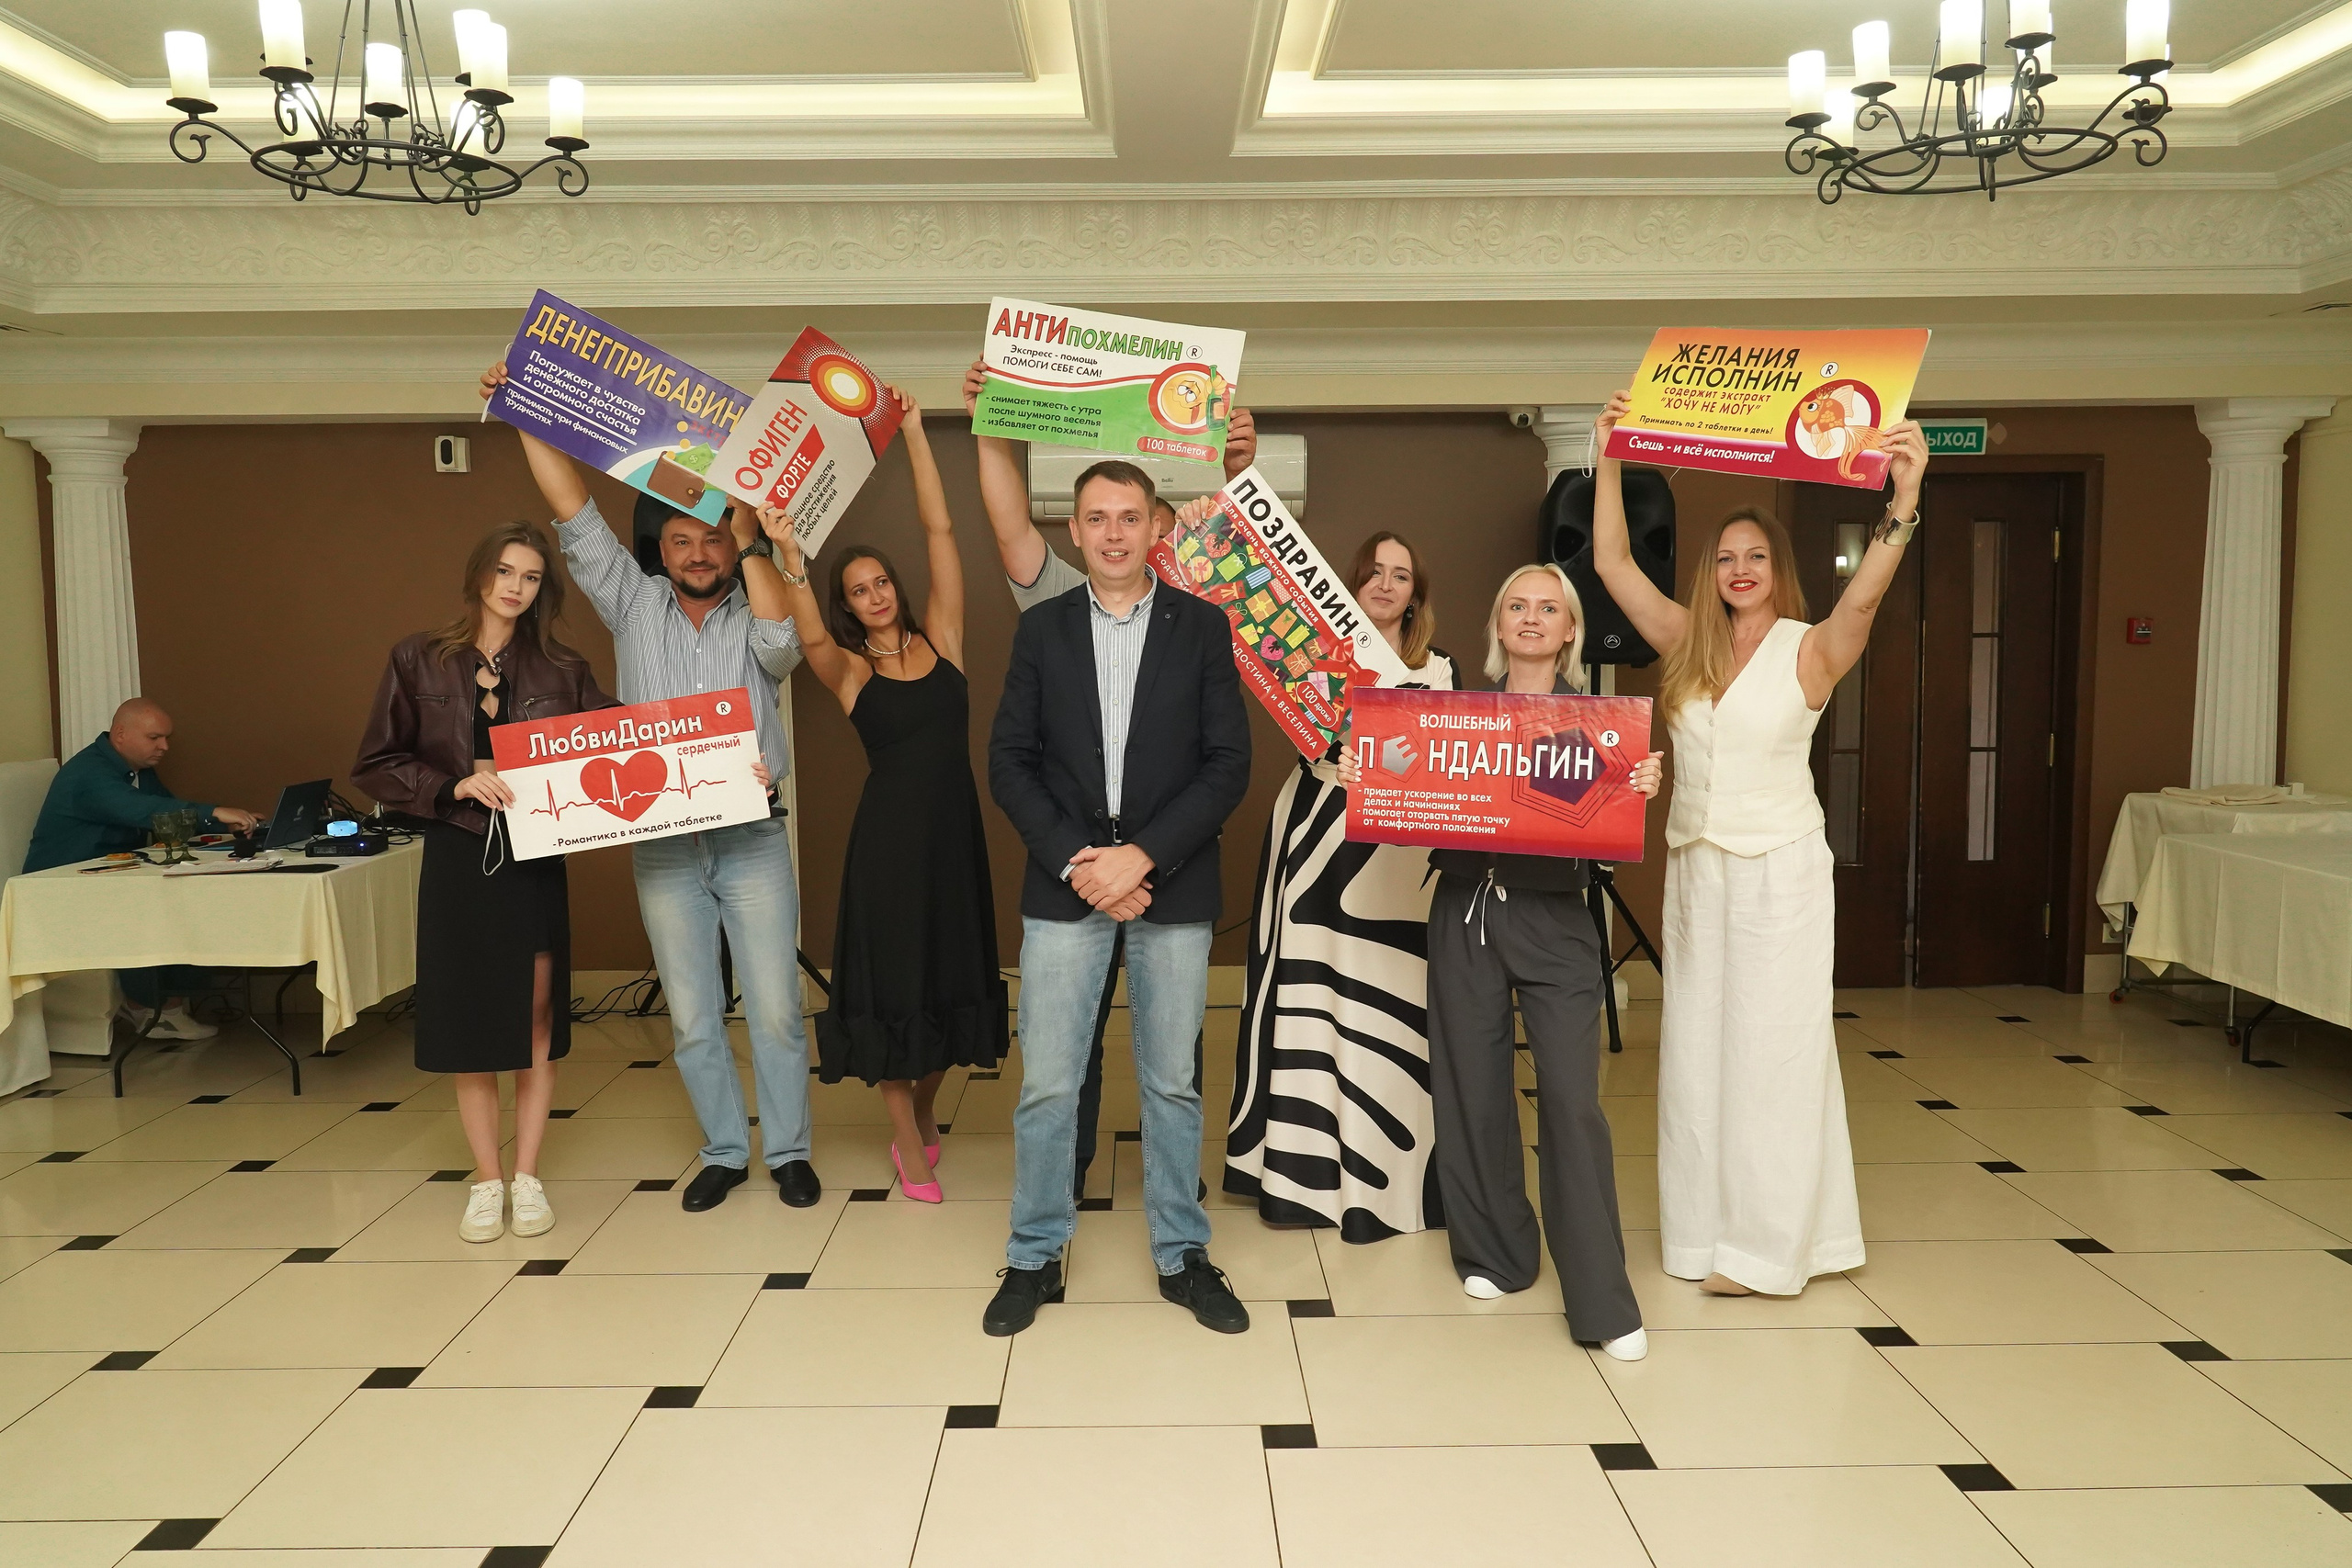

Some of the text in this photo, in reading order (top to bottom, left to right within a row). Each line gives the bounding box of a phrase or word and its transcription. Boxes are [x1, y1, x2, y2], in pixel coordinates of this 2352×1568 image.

[992, 308, 1183, 361] АНТИПОХМЕЛИН
[1003, 356, 1102, 378] ПОМОГИ СЕБЕ САМ!
[1010, 344, 1052, 359] Экспресс
[1060, 354, 1098, 366] помощь
[1671, 344, 1801, 369] ЖЕЛАНИЯ
[526, 305, 745, 434] ДЕНЕГПРИБАВИН
[529, 350, 646, 417] Погружает в чувство
[1652, 364, 1803, 392] ИСПОЛНИН
[523, 374, 638, 435] и огромного счастья
[524, 363, 641, 425] денежного достатка
[991, 396, 1030, 406] снимает
[1033, 400, 1069, 411] тяжесть
[1078, 406, 1102, 417] утра
[1664, 387, 1771, 403] содержит экстракт
[1701, 400, 1720, 412] НЕ
[504, 397, 553, 426] трудностях
[507, 388, 553, 417] принимать
[553, 412, 571, 430] при
[572, 420, 628, 454] финансовых
[988, 407, 1101, 426] после шумного веселья
[1639, 415, 1682, 427] Принимать
[1705, 423, 1742, 433] таблетки
[1750, 426, 1773, 435] день!
[988, 418, 1035, 431] избавляет
[1051, 426, 1099, 439] похмелья
[1926, 433, 1976, 448] ЫХОД
[735, 399, 808, 491] ОФИГЕН
[1146, 437, 1206, 457] 100 таблеток
[1628, 435, 1664, 452] Съешь
[1673, 445, 1681, 453] и
[1683, 443, 1703, 456] всё
[1703, 448, 1775, 463] исполнится!
[776, 453, 811, 498] ФОРТЕ
[790, 460, 835, 522] ощное средство
[795, 474, 836, 535] для достижения
[802, 488, 838, 540] любых целей
[1221, 501, 1318, 623] Для очень важного события
[1232, 478, 1359, 637] ПОЗДРАВИН
[1302, 685, 1332, 722] 100 драже
[1277, 701, 1317, 750] ВЕСЕЛИНА
[1420, 713, 1510, 731] ВОЛШЕБНЫЙ
[529, 715, 702, 759] ЛюбвиДарин
[676, 735, 741, 758] сердечный
[1363, 787, 1402, 800] придает
[1404, 791, 1454, 803] ускорение
[1470, 794, 1492, 803] всех
[1363, 797, 1393, 808] делах
[1403, 801, 1461, 810] начинаниях
[628, 821, 671, 836] каждой
[673, 814, 722, 827] таблетке
[1363, 808, 1405, 819] помогает
[1408, 811, 1450, 821] оторвать
[1452, 814, 1480, 825] пятую
[1483, 816, 1510, 828] точку
[1363, 818, 1496, 834] от комфортного положения
